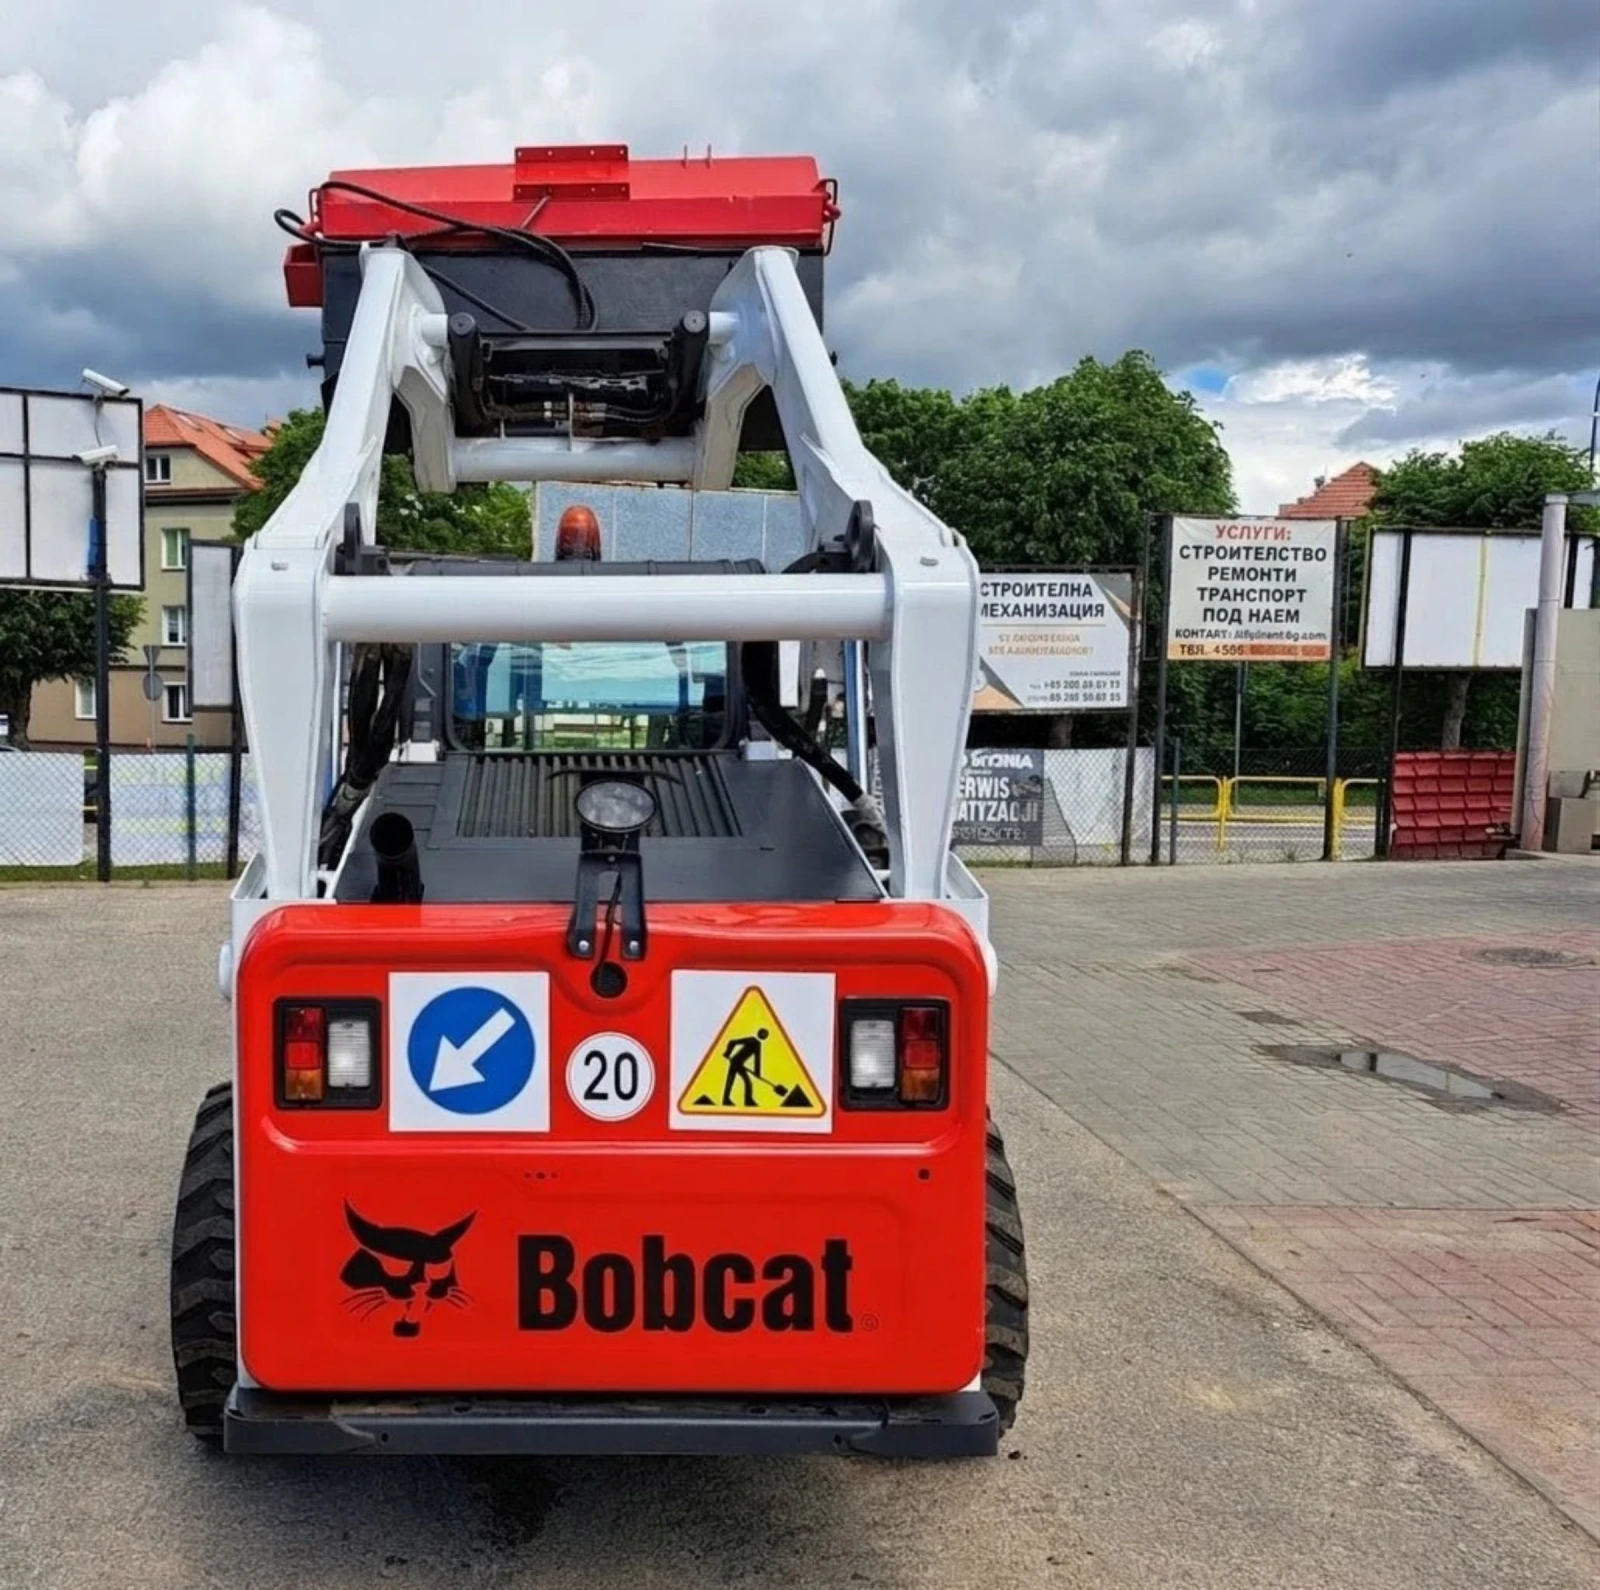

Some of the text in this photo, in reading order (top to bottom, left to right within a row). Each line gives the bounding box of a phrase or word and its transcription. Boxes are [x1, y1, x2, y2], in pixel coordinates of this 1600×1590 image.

[1215, 525, 1292, 541] УСЛУГИ:
[1207, 566, 1297, 583] РЕМОНТИ
[980, 582, 1093, 598] СТРОИТЕЛНА
[1197, 587, 1307, 603] ТРАНСПОРТ
[1203, 608, 1300, 625] ПОД НАЕМ
[582, 1050, 639, 1102] 20
[517, 1234, 853, 1333] Bobcat
